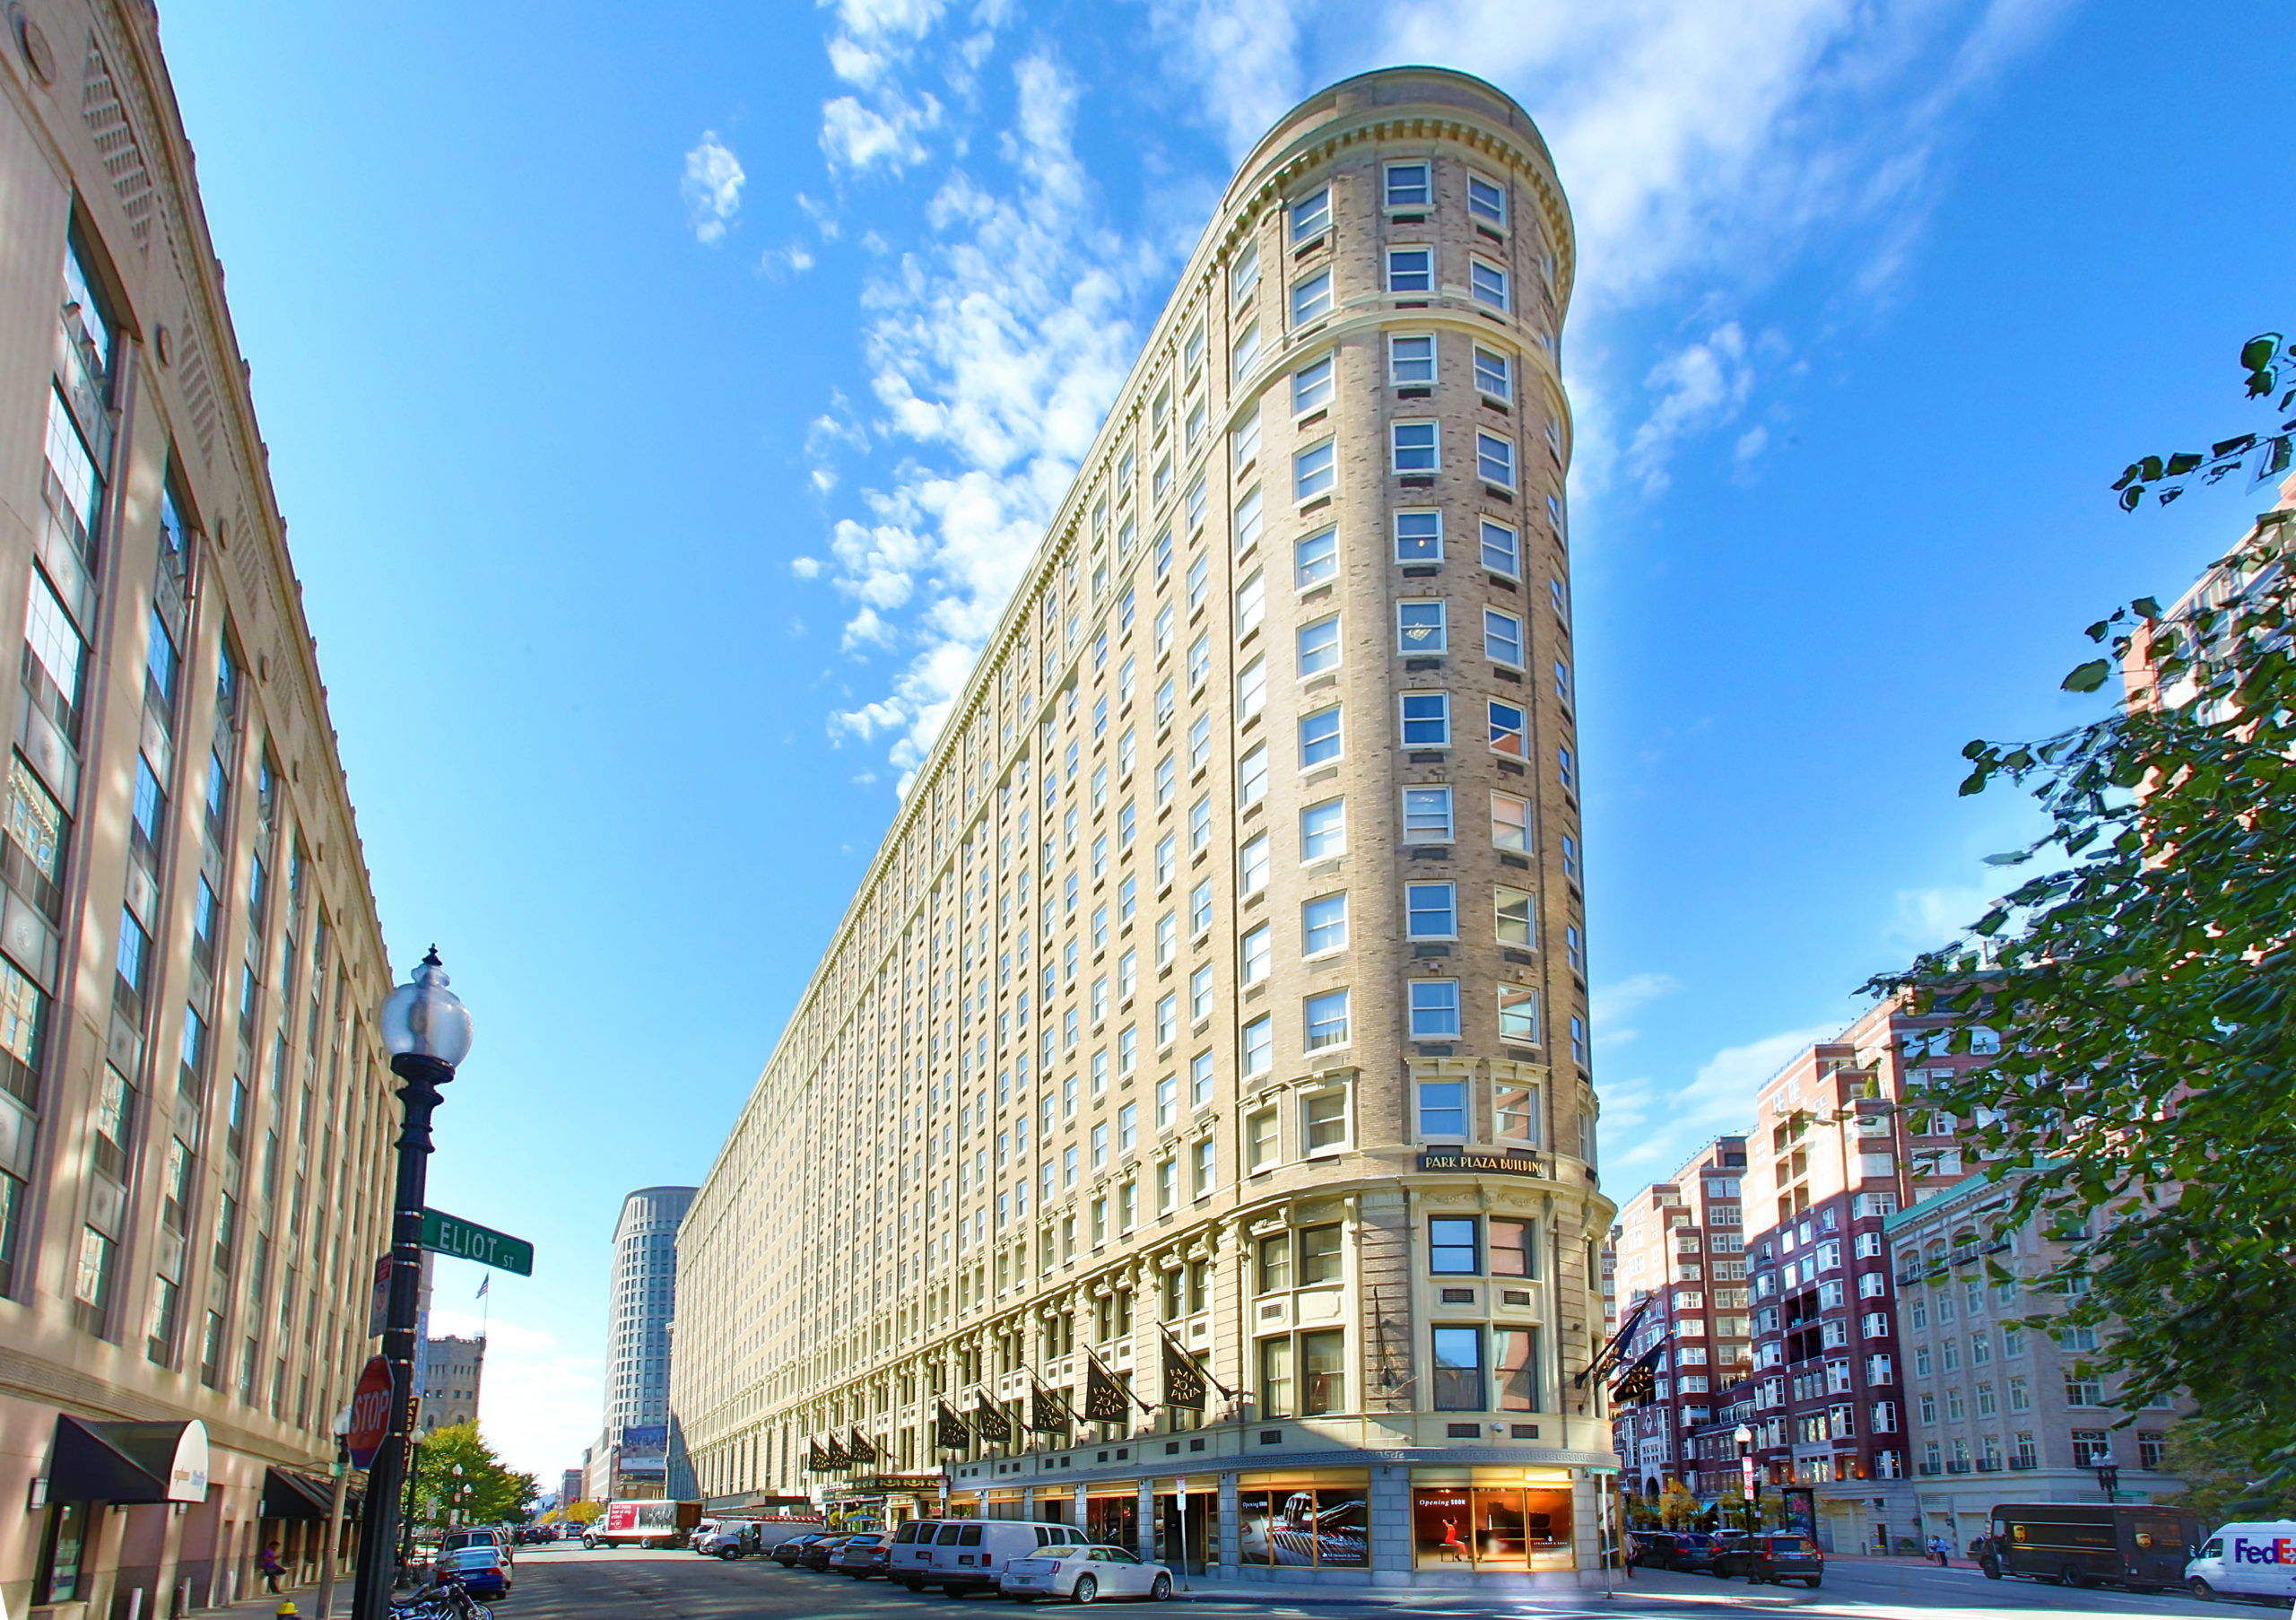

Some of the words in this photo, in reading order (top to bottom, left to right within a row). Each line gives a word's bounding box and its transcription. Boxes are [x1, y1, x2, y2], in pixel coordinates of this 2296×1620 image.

[1425, 1156, 1457, 1169] PARK
[1460, 1156, 1498, 1169] PLAZA
[1500, 1158, 1544, 1173] BUILDING
[439, 1221, 498, 1263] ELIOT
[503, 1254, 515, 1268] ST
[1170, 1368, 1196, 1384] PARK
[1173, 1377, 1188, 1391] 20
[1092, 1386, 1119, 1400] PARK
[1170, 1387, 1201, 1401] PLAZA
[1095, 1394, 1111, 1407] 20
[351, 1389, 390, 1434] STOP
[1092, 1403, 1123, 1415] PLAZA
[1242, 1501, 1258, 1509] Opening
[1419, 1499, 1449, 1507] Opening
